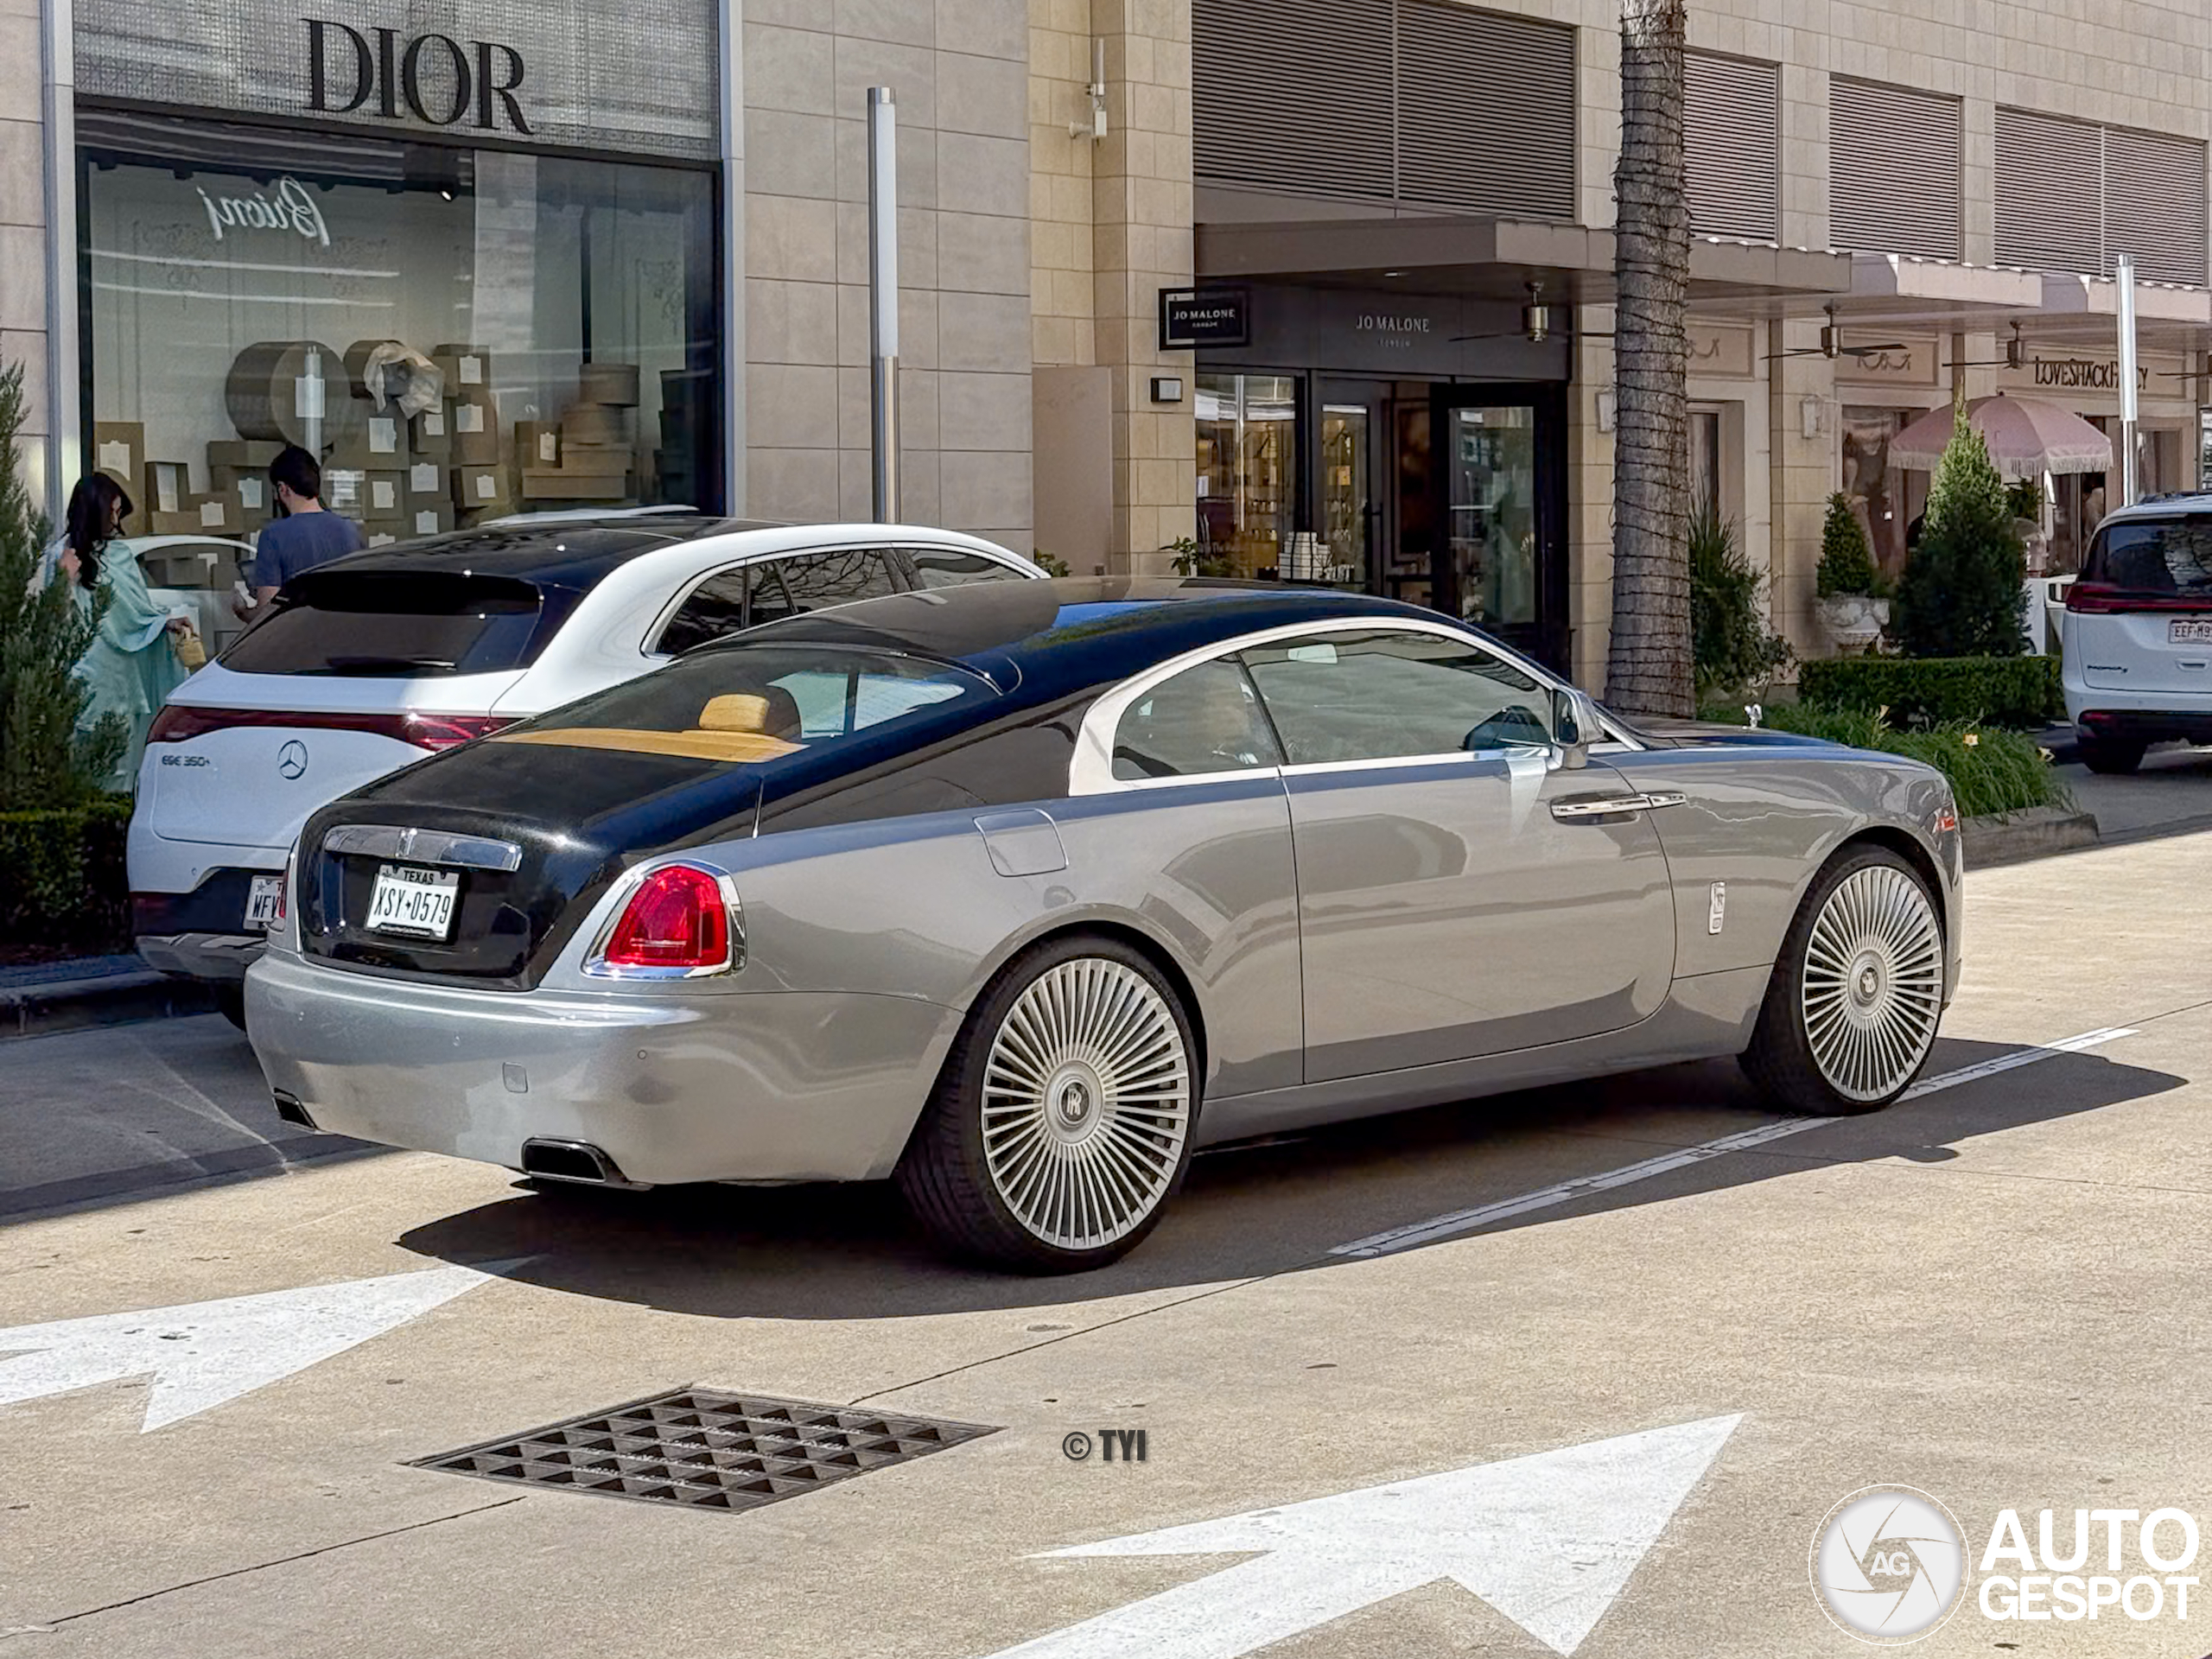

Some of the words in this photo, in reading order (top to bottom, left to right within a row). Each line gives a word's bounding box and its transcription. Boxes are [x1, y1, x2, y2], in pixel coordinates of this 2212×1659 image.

[298, 18, 535, 135] DIOR
[1173, 310, 1188, 321] JO
[1189, 308, 1236, 320] MALONE
[1355, 315, 1374, 330] JO
[1376, 315, 1430, 334] MALONE
[404, 869, 435, 886] TEXAS
